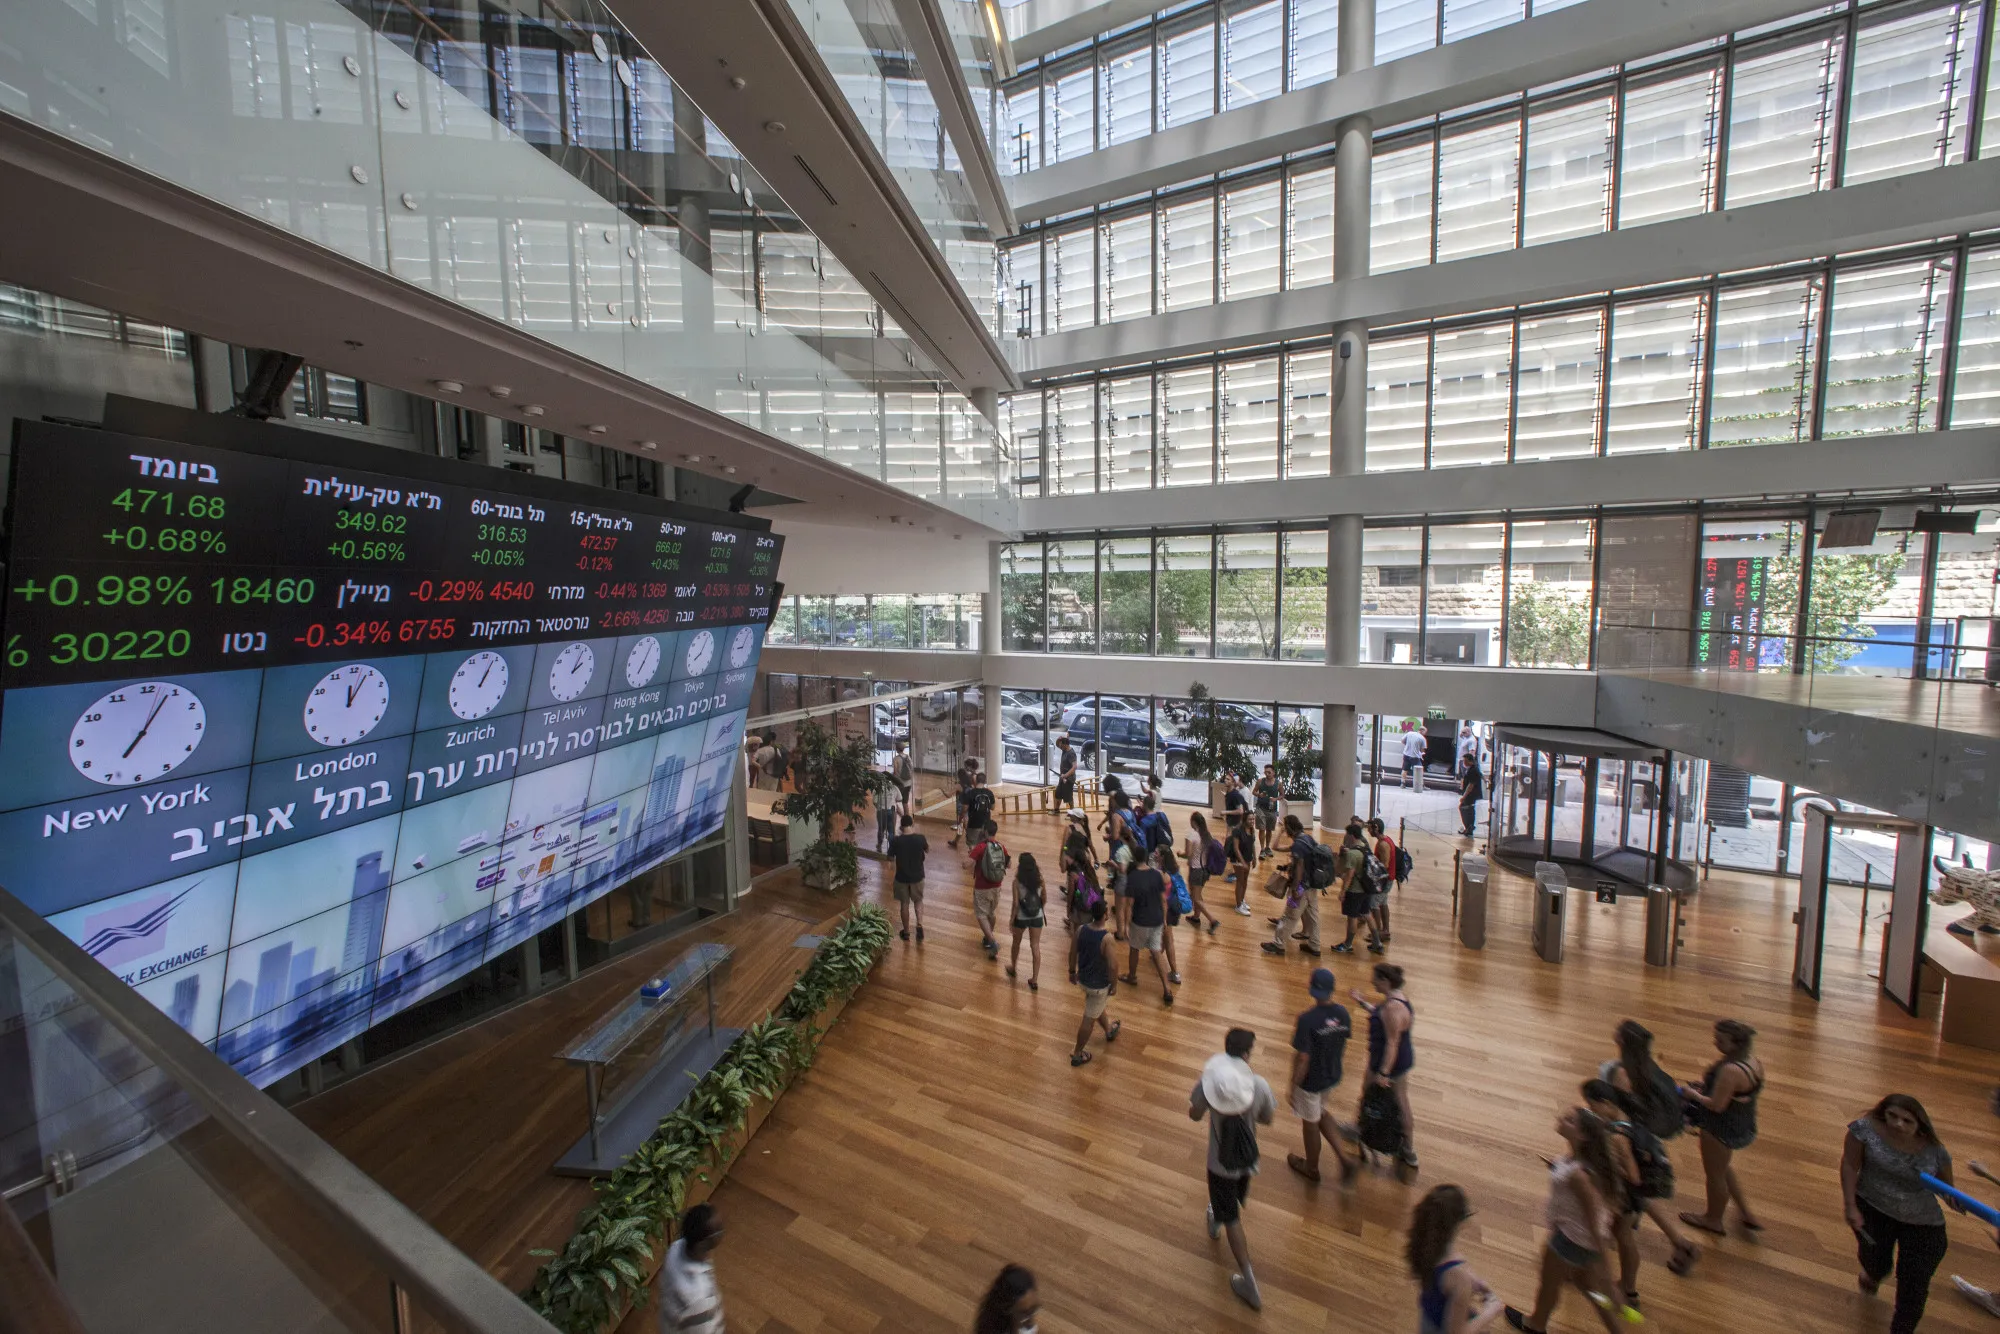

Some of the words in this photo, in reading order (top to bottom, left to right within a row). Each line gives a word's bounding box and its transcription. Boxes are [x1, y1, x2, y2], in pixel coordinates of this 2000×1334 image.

[130, 453, 219, 485] ביומד
[303, 476, 401, 508] טק-עילית
[406, 490, 442, 511] ת"א
[112, 488, 226, 520] 471.68
[471, 499, 523, 520] בונד-60
[528, 505, 545, 522] תל
[336, 510, 407, 534] 349.62
[570, 510, 612, 530] נדל"ן-15
[614, 518, 632, 532] ת"א
[660, 522, 686, 536] יתר-50
[103, 527, 227, 555] +0.68%
[478, 524, 527, 544] 316.53
[580, 536, 618, 551] 472.57
[328, 541, 405, 562] +0.56%
[472, 549, 525, 566] +0.05%
[576, 556, 613, 572] -0.12%
[650, 559, 679, 571] +0.43%
[14, 574, 192, 606] +0.98%
[211, 578, 315, 604] 18460
[337, 580, 391, 608] מיילן
[409, 580, 484, 602] -0.29%
[490, 581, 534, 600] 4540
[548, 586, 584, 600] מזרחי
[594, 583, 637, 599] -0.44%
[642, 582, 667, 598] 1369
[674, 584, 696, 598] לאומי
[1751, 571, 1762, 601] +0.15%
[536, 616, 589, 633] נורסטאר
[598, 610, 640, 628] -2.66%
[643, 609, 669, 624] 4250
[675, 610, 694, 622] נובה
[1702, 611, 1711, 630] 1746
[294, 622, 391, 648] -0.34%
[398, 618, 456, 643] 6755
[470, 619, 530, 640] החזקות
[50, 629, 191, 664] 30220
[222, 632, 267, 654] נטו
[684, 680, 705, 694] Tokyo
[725, 671, 747, 685] Sydney
[108, 694, 126, 703] 11
[140, 685, 156, 694] 12
[614, 696, 637, 710] Hong
[638, 690, 660, 705] Kong
[688, 692, 726, 717] ברוכים
[84, 713, 102, 722] 10
[543, 711, 561, 726] Tel
[563, 705, 587, 721] Aviv
[639, 705, 684, 730] הבאים
[446, 724, 496, 748] Zurich
[565, 712, 634, 752] לבורסה
[76, 739, 84, 747] 9
[473, 731, 559, 778] לניירות
[295, 751, 377, 782] London
[408, 759, 466, 802] ערך
[43, 803, 128, 838] New
[140, 782, 211, 815] York
[313, 780, 393, 821] בתל
[170, 802, 297, 862] אביב
[139, 944, 209, 980] EXCHANGE
